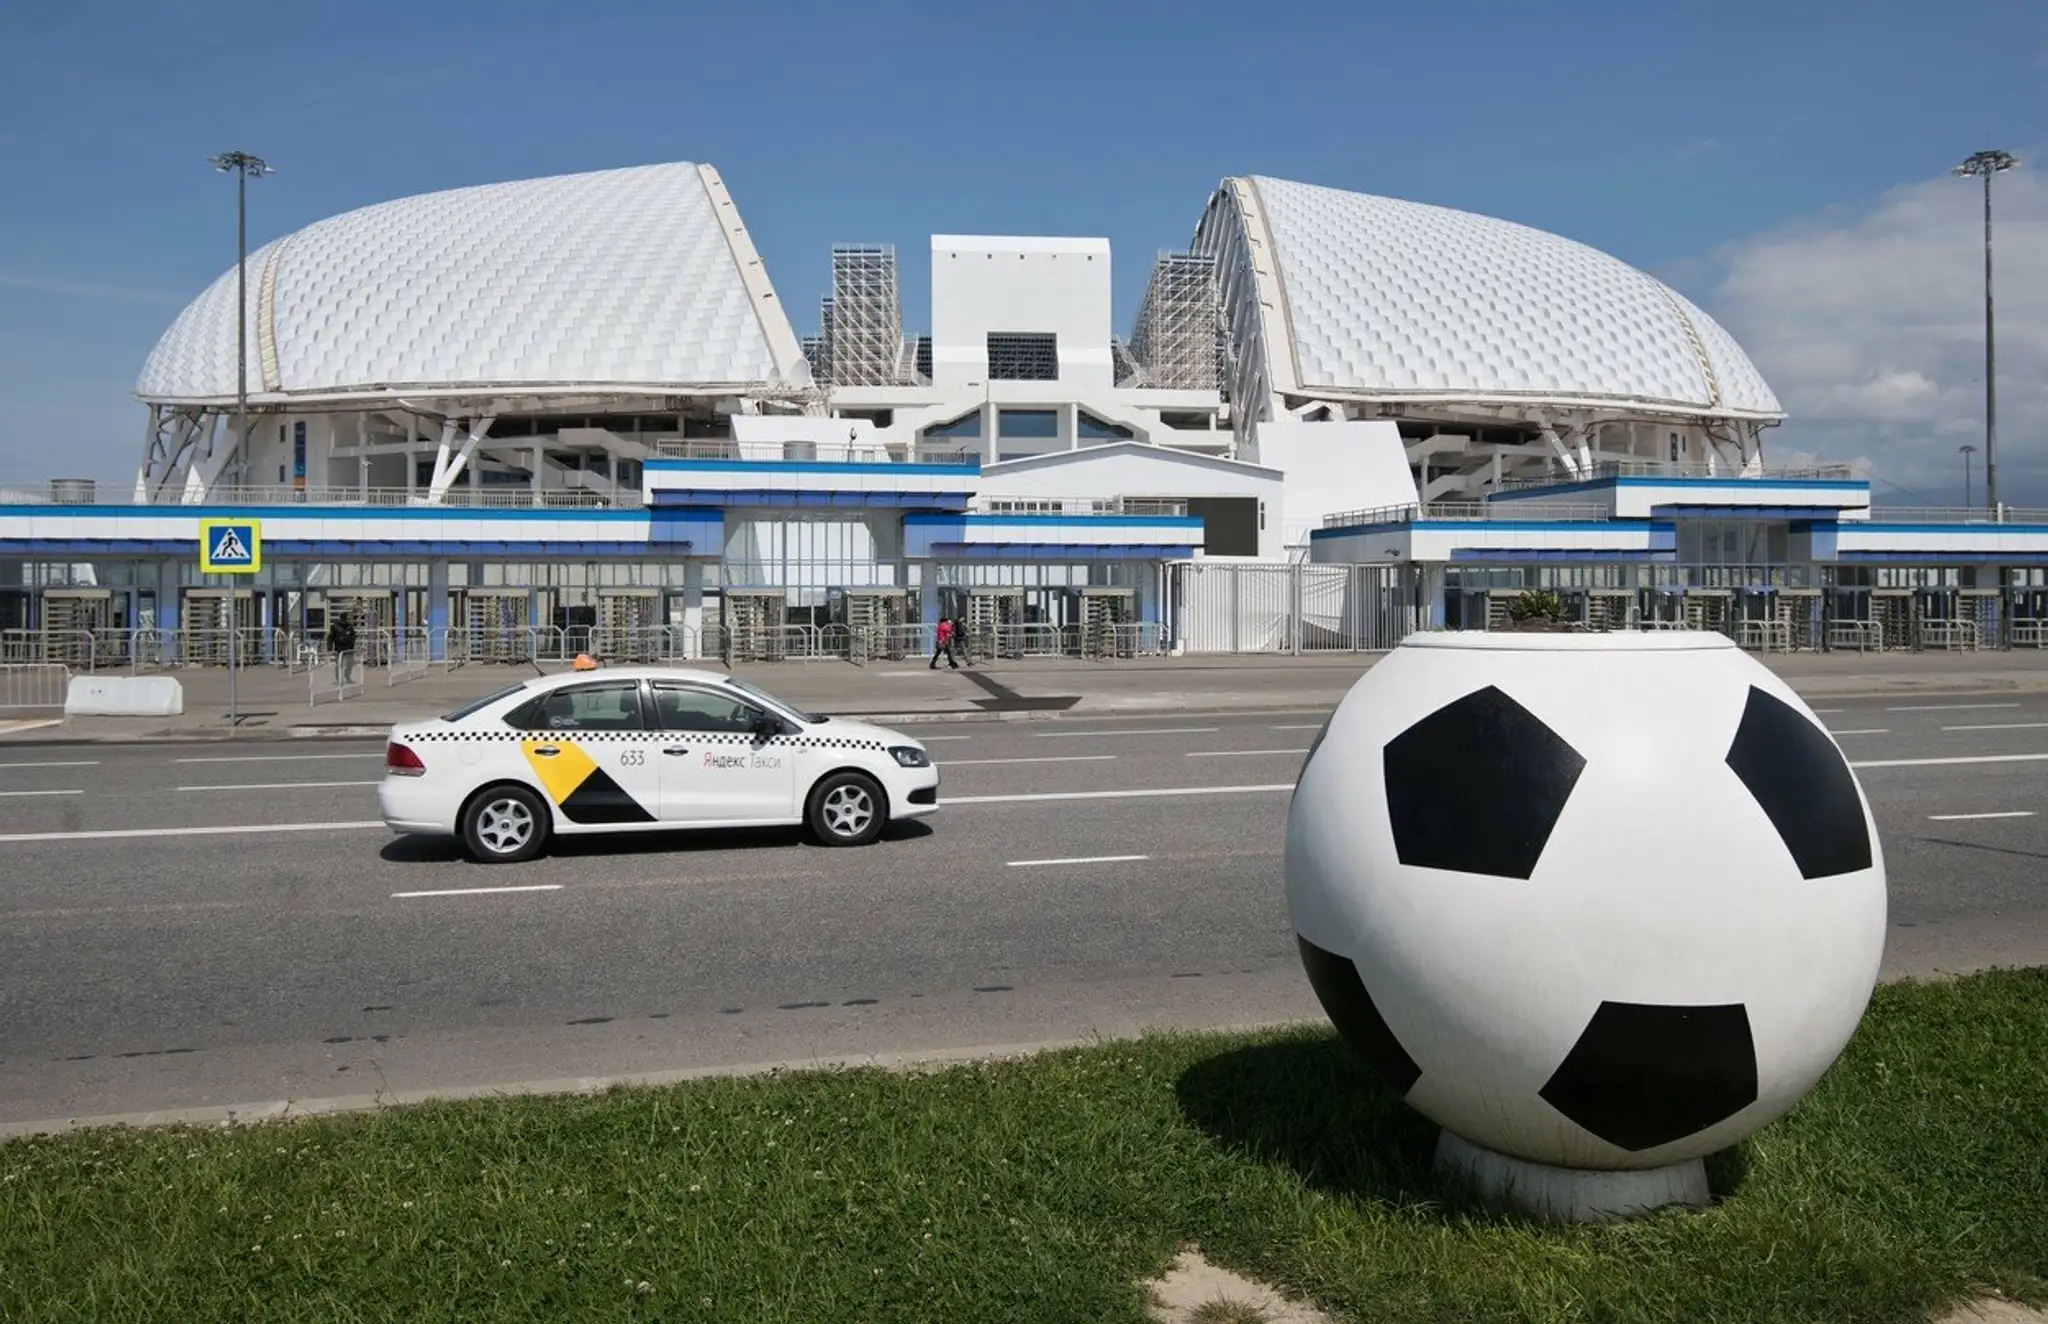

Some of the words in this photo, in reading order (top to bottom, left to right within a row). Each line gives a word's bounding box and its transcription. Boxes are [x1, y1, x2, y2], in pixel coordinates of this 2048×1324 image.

[620, 749, 645, 766] 633
[703, 752, 745, 768] Яндекс
[750, 752, 781, 768] Такси
